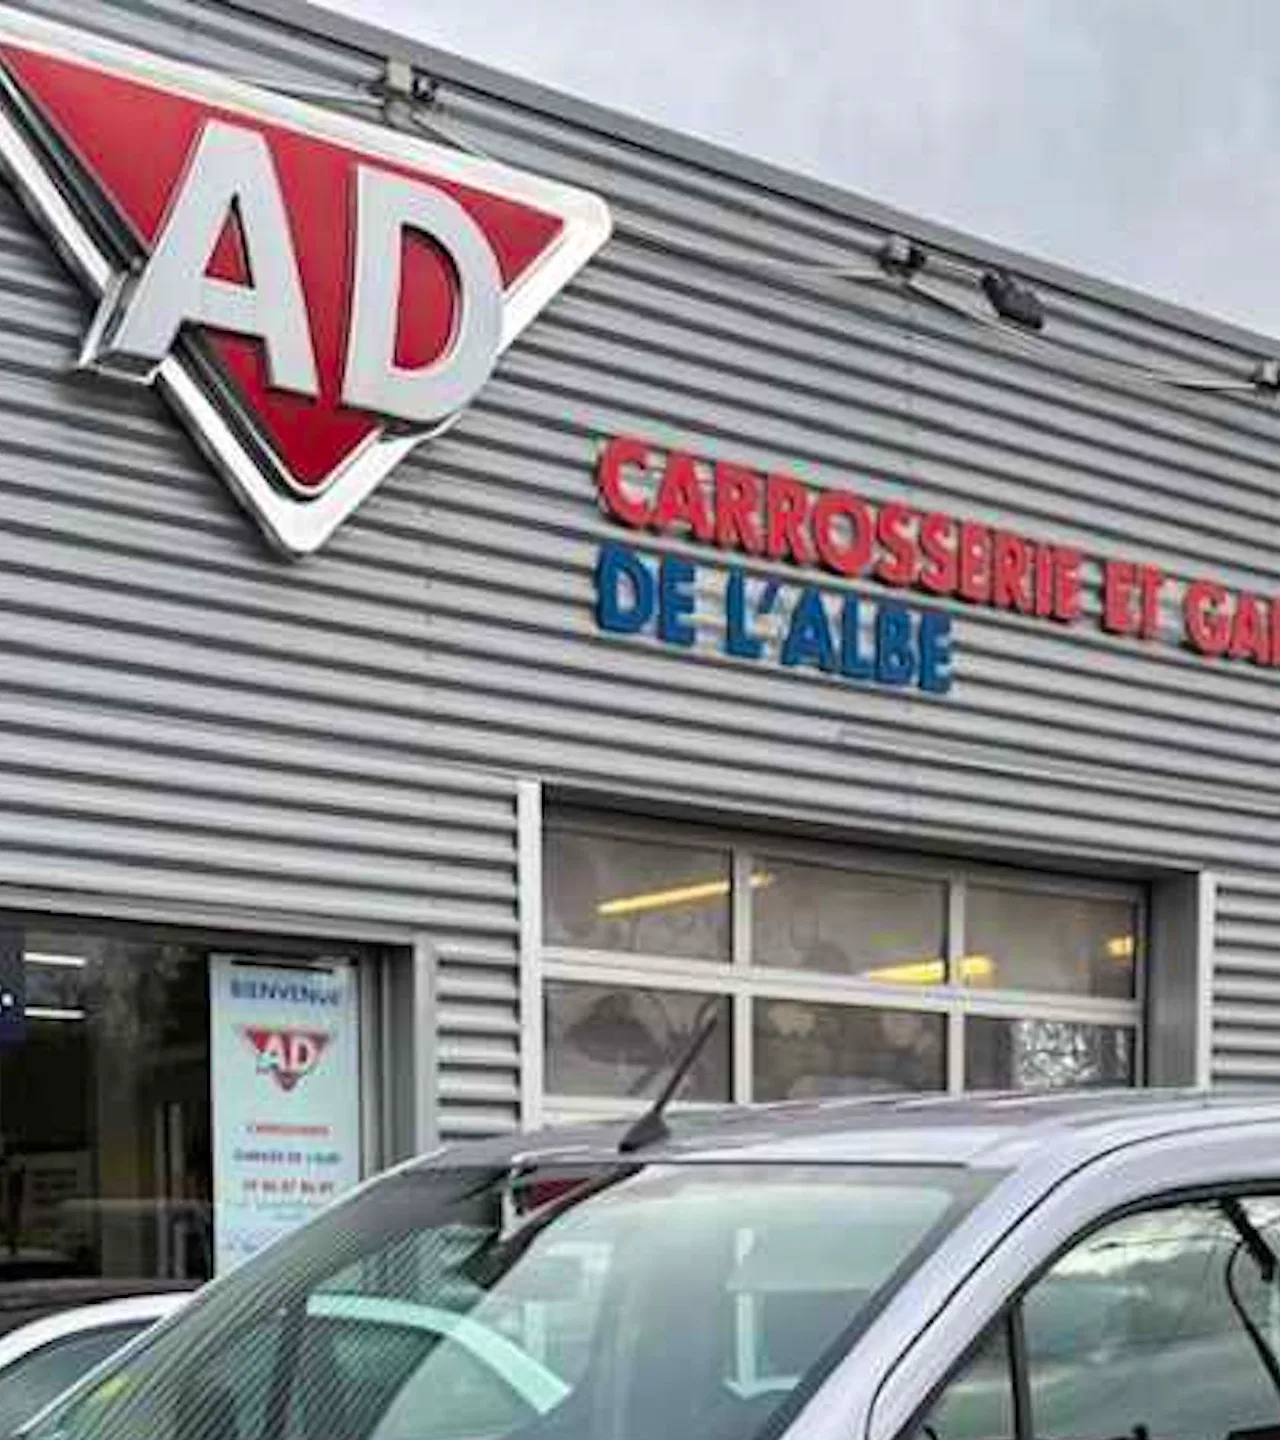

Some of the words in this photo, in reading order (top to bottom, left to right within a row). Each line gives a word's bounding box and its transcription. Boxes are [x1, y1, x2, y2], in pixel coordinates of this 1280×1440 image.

[105, 118, 505, 423] AD
[594, 541, 699, 648] DE
[724, 561, 954, 694] L'ALBE
[595, 434, 1082, 624] CARROSSERIE
[1102, 560, 1163, 640] ET
[256, 1031, 320, 1073] AD
